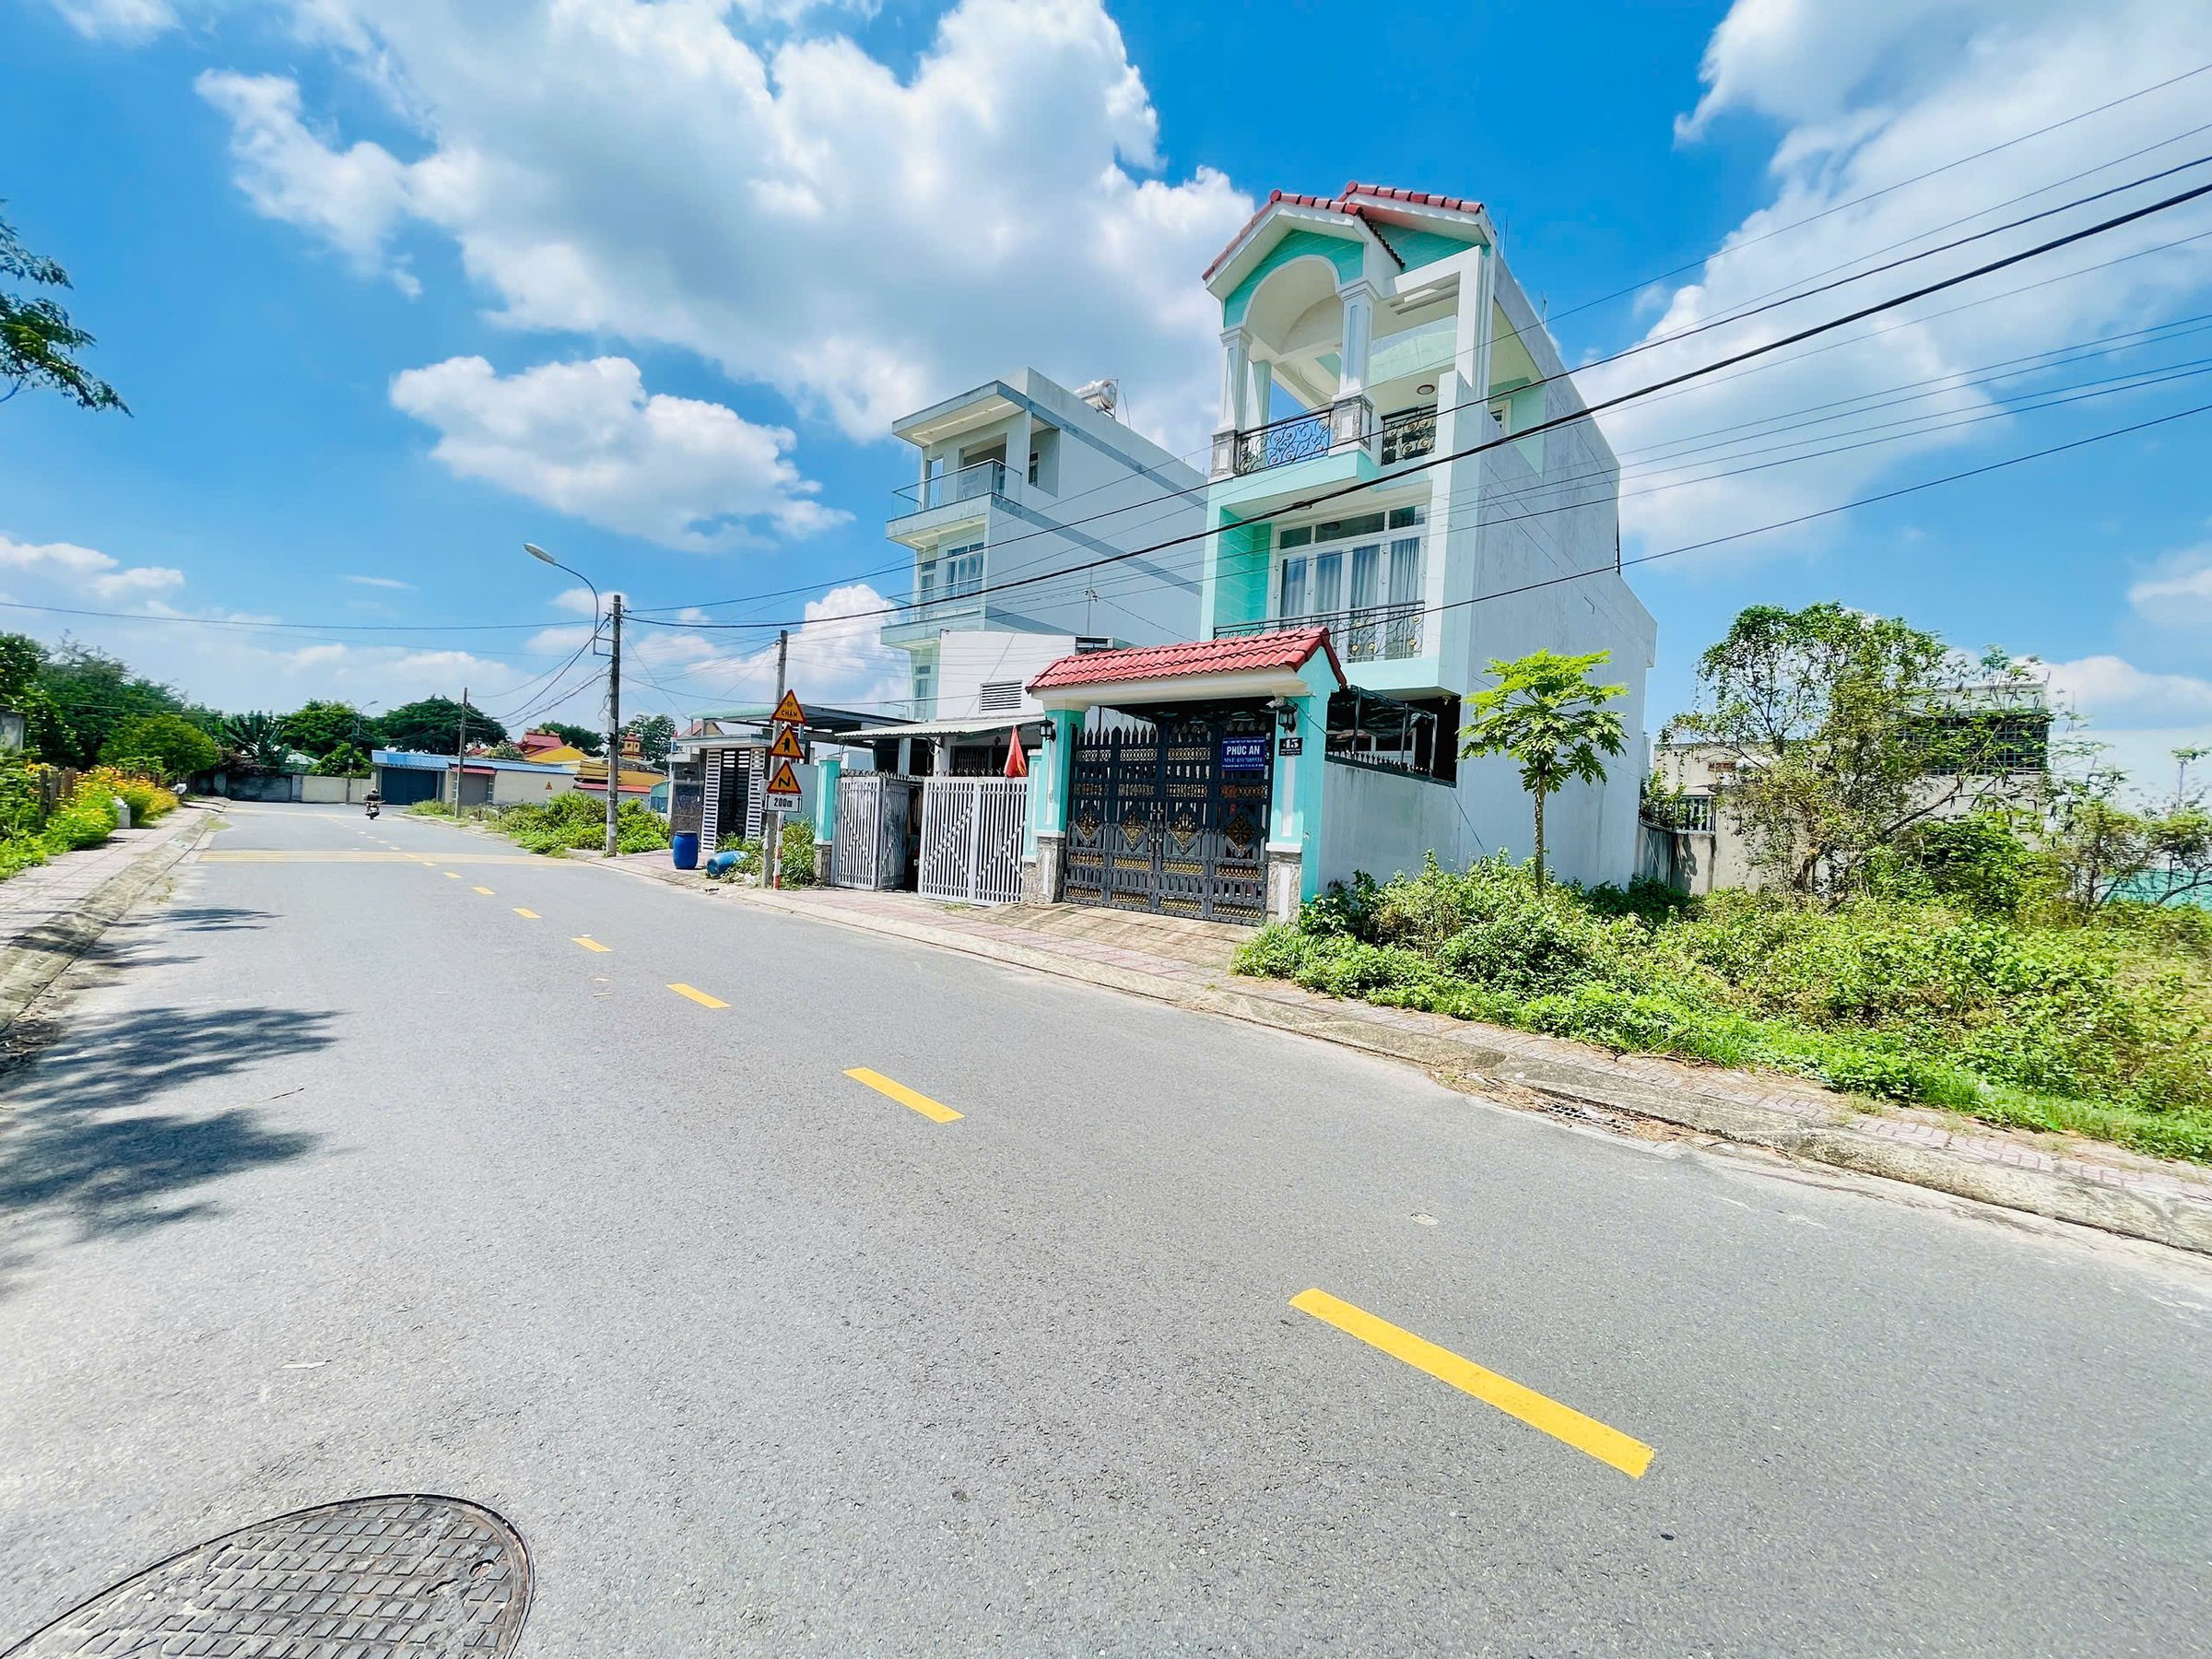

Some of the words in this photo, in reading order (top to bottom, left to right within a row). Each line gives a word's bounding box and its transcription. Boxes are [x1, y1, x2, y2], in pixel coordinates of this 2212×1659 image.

[1227, 744, 1247, 756] PHÚC
[1249, 745, 1260, 755] AN
[773, 797, 793, 807] 200m
